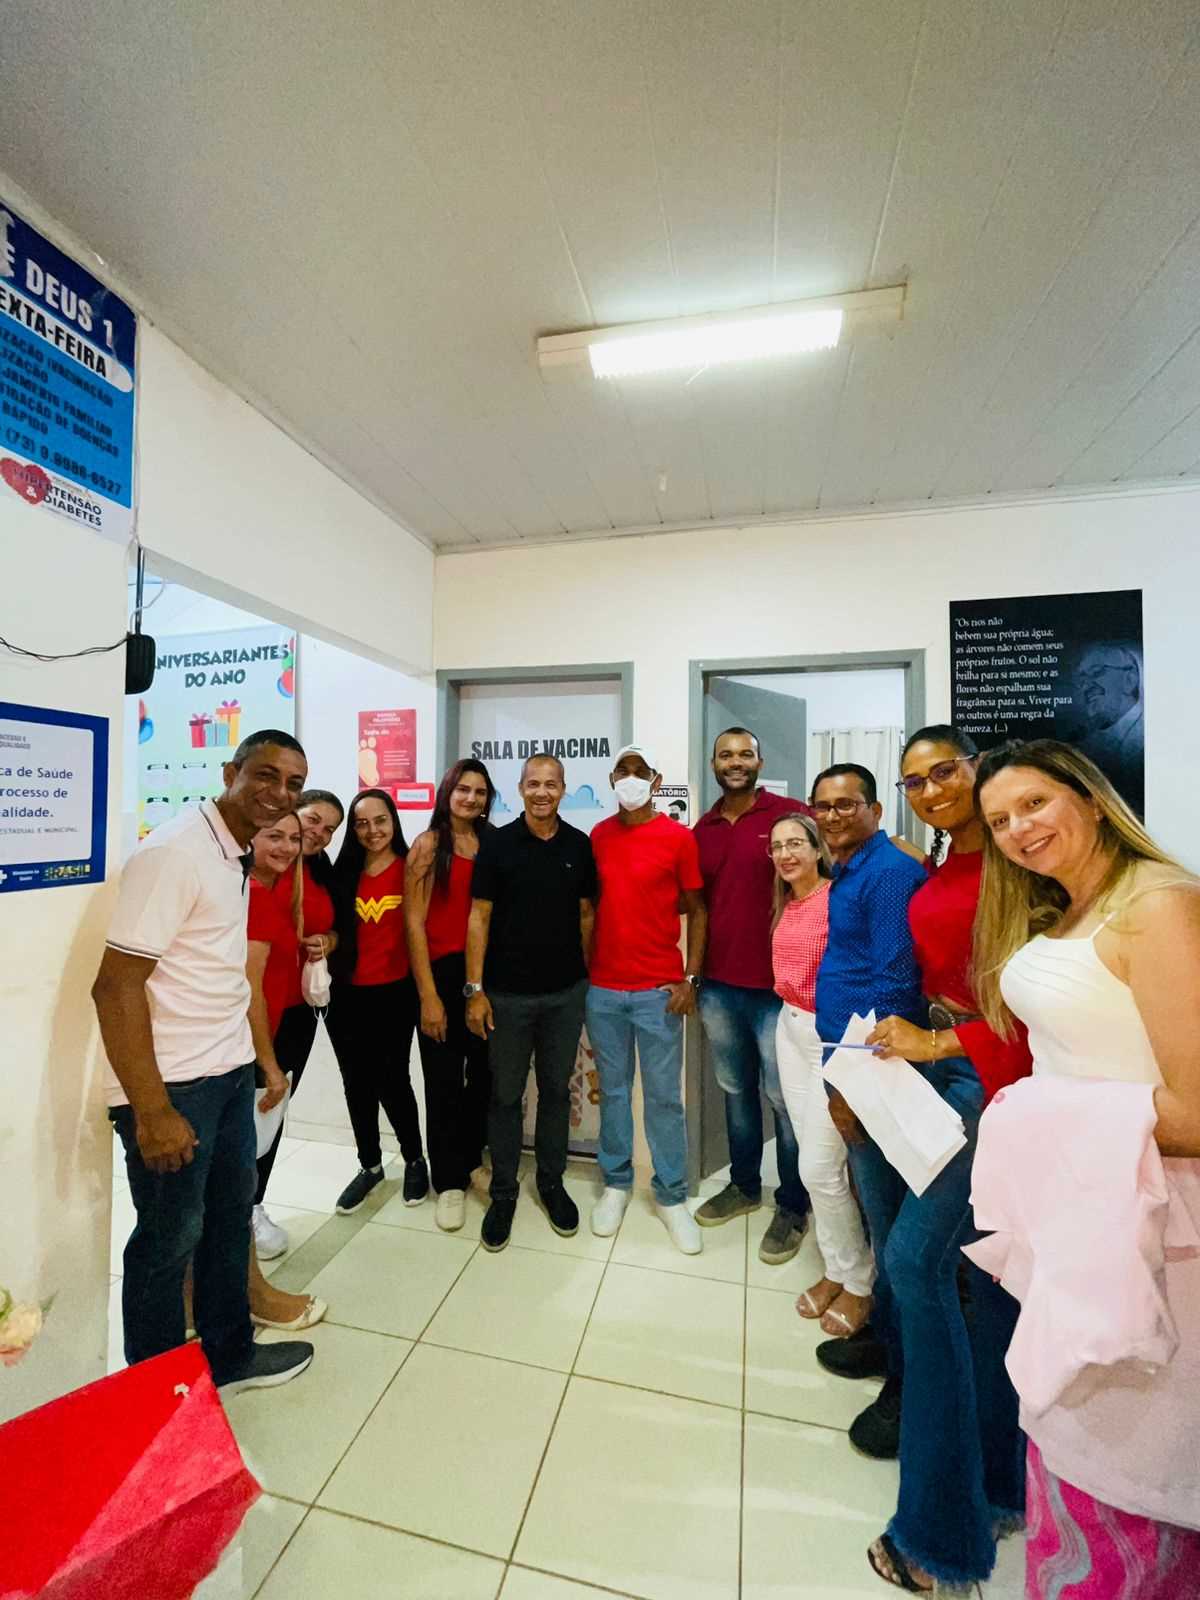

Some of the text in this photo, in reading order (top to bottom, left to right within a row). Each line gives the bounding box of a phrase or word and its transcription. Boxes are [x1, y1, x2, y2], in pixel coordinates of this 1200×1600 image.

[26, 258, 93, 332] DEUS
[103, 319, 113, 348] 1
[43, 494, 102, 527] DIABETES
[987, 616, 1003, 626] não
[955, 631, 982, 640] bebem
[983, 631, 998, 639] sua
[999, 629, 1030, 641] própria
[966, 644, 995, 653] árvores
[996, 643, 1012, 652] não
[1013, 643, 1044, 651] comem
[1045, 642, 1064, 650] seus
[155, 644, 289, 670] NIVERSARIANTES
[956, 657, 990, 670] próprios
[1018, 654, 1028, 665] O
[1028, 654, 1041, 664] sol
[1042, 654, 1058, 664] não
[185, 669, 246, 688] DO ANO
[956, 670, 979, 680] brilha
[980, 672, 999, 682] para
[1042, 670, 1049, 678] e
[1049, 669, 1059, 678] as
[956, 683, 978, 693] flores
[979, 684, 995, 693] não
[996, 681, 1035, 695] espalham
[997, 698, 1016, 709] para
[1029, 695, 1051, 705] Viver
[1053, 696, 1073, 708] para
[956, 707, 1055, 721] os outros é uma regra da
[471, 737, 611, 760] SALA DE VACINA
[16, 766, 33, 778] de
[37, 767, 73, 779] Saúde
[53, 787, 68, 798] de
[1, 806, 54, 818] alidade.
